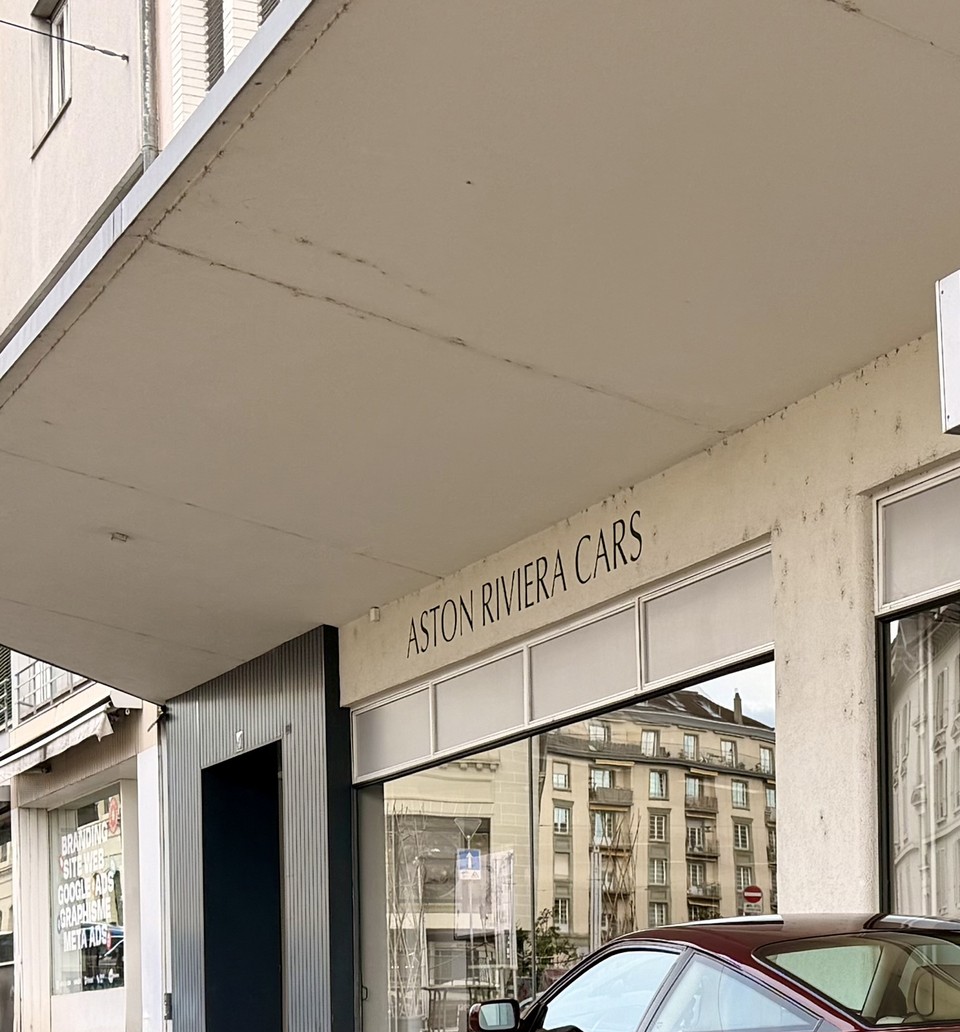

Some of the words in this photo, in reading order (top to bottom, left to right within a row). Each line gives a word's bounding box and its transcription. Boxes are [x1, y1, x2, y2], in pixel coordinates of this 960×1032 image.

[406, 589, 474, 659] ASTON
[482, 548, 567, 627] RIVIERA
[575, 510, 643, 584] CARS
[61, 820, 109, 857] BRANDING
[63, 855, 82, 880] SITE
[83, 848, 105, 874] WEB
[58, 877, 91, 905] GOOGLE
[95, 871, 115, 896] ADS
[60, 896, 112, 929] GRAPHISME
[63, 928, 88, 953] META
[88, 924, 108, 948] ADS
